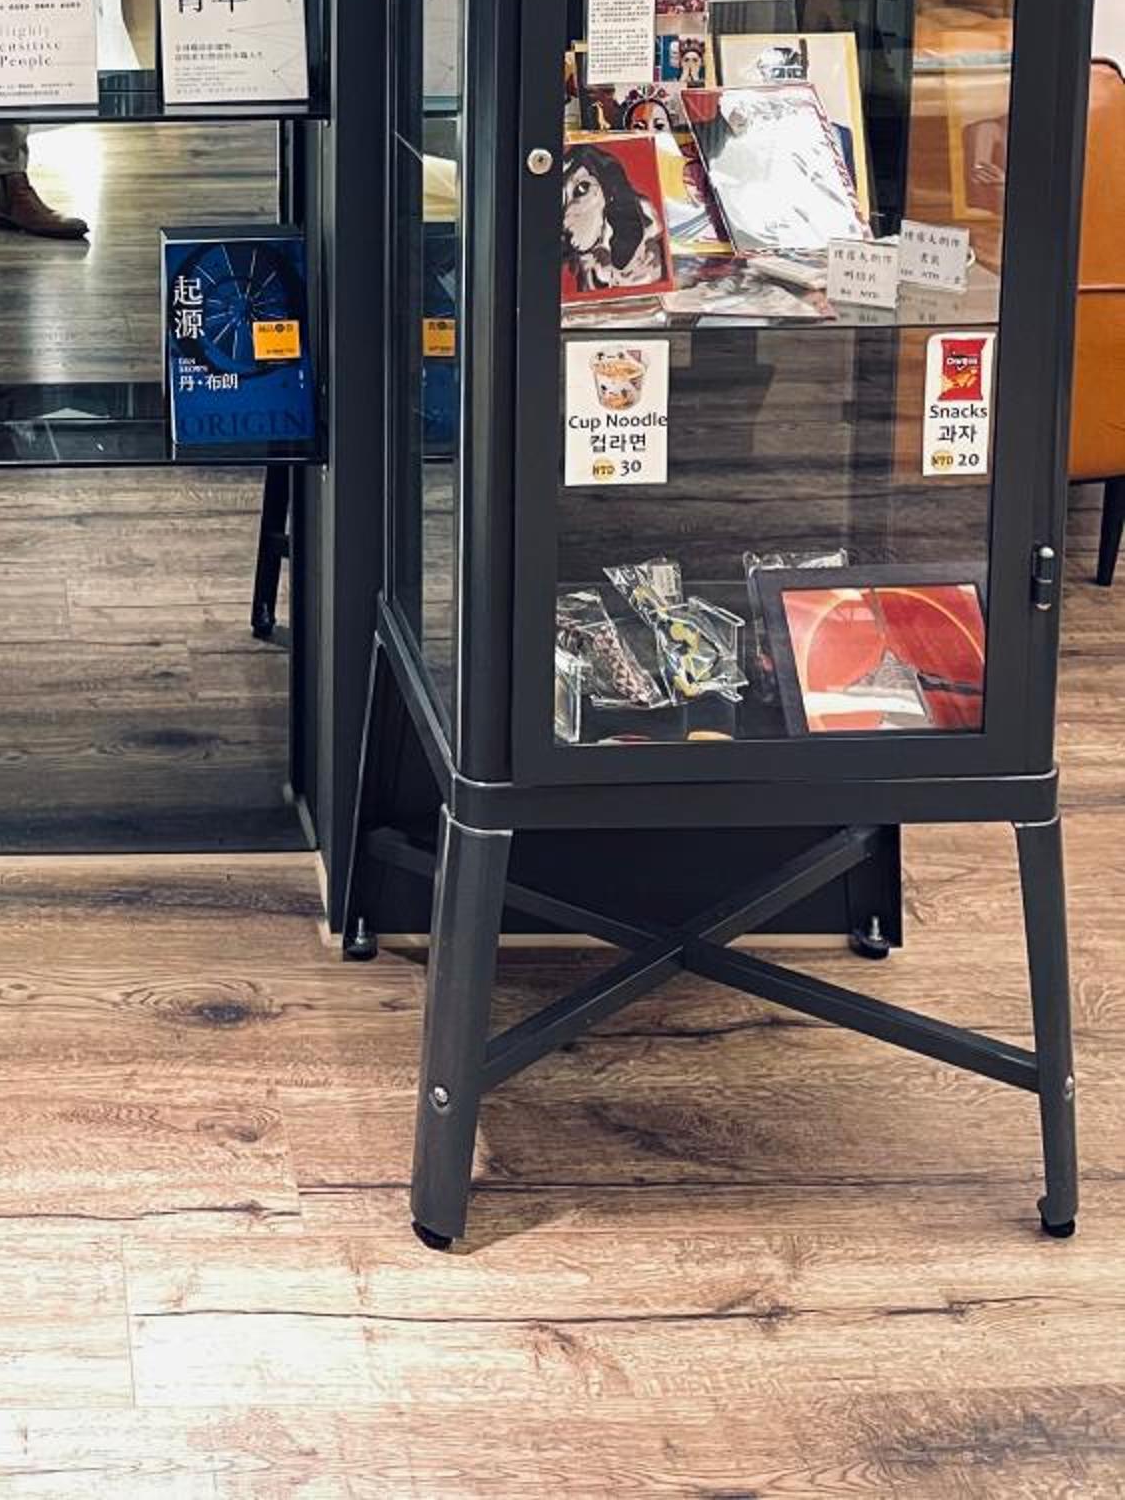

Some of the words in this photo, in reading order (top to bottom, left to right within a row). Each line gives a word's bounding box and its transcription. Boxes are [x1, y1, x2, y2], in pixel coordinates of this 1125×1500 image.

[0, 55, 52, 71] People
[173, 275, 205, 340] 起源
[929, 404, 988, 419] Snacks
[180, 410, 308, 437] ORIGIN
[568, 415, 602, 432] Cup
[606, 412, 668, 429] Noodle
[590, 433, 646, 453] 컵라면
[938, 424, 977, 443] 과자
[620, 460, 642, 477] 30
[958, 453, 980, 467] 20
